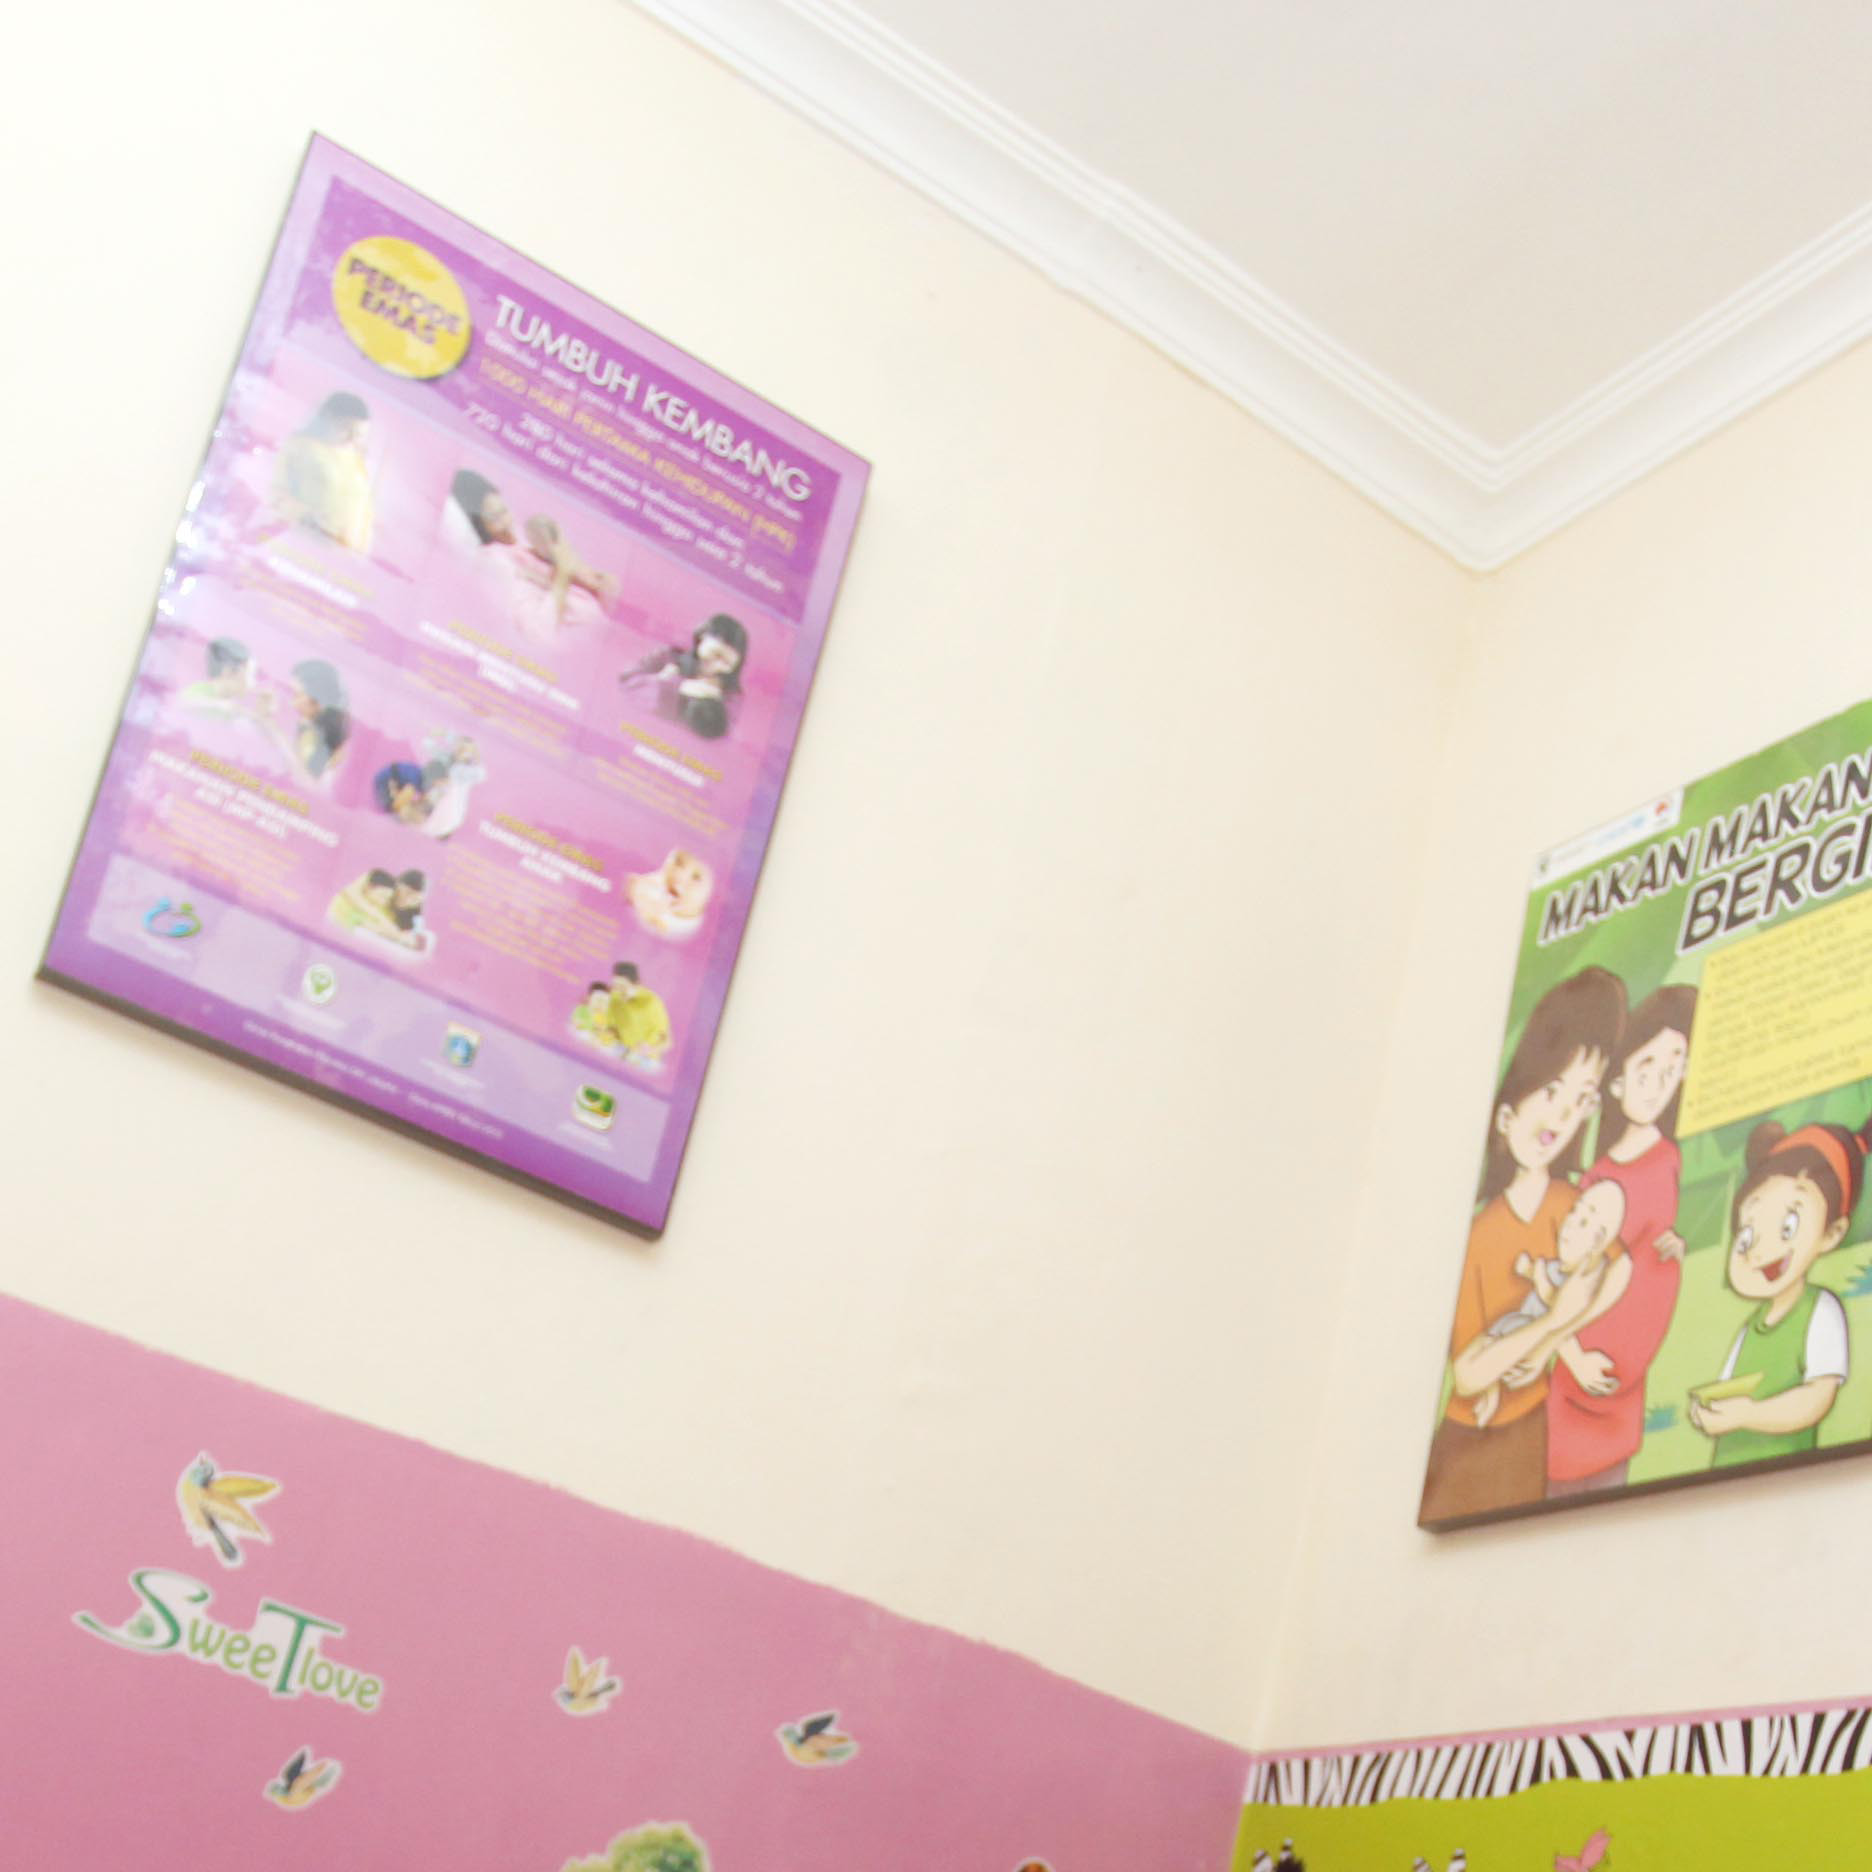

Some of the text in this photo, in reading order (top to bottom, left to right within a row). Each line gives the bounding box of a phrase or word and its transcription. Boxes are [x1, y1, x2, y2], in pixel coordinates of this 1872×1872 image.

[347, 257, 463, 337] PERIODE
[359, 289, 439, 346] EMAS
[494, 294, 813, 503] TUMBUH KEMBANG
[1541, 832, 1694, 942] MAKAN
